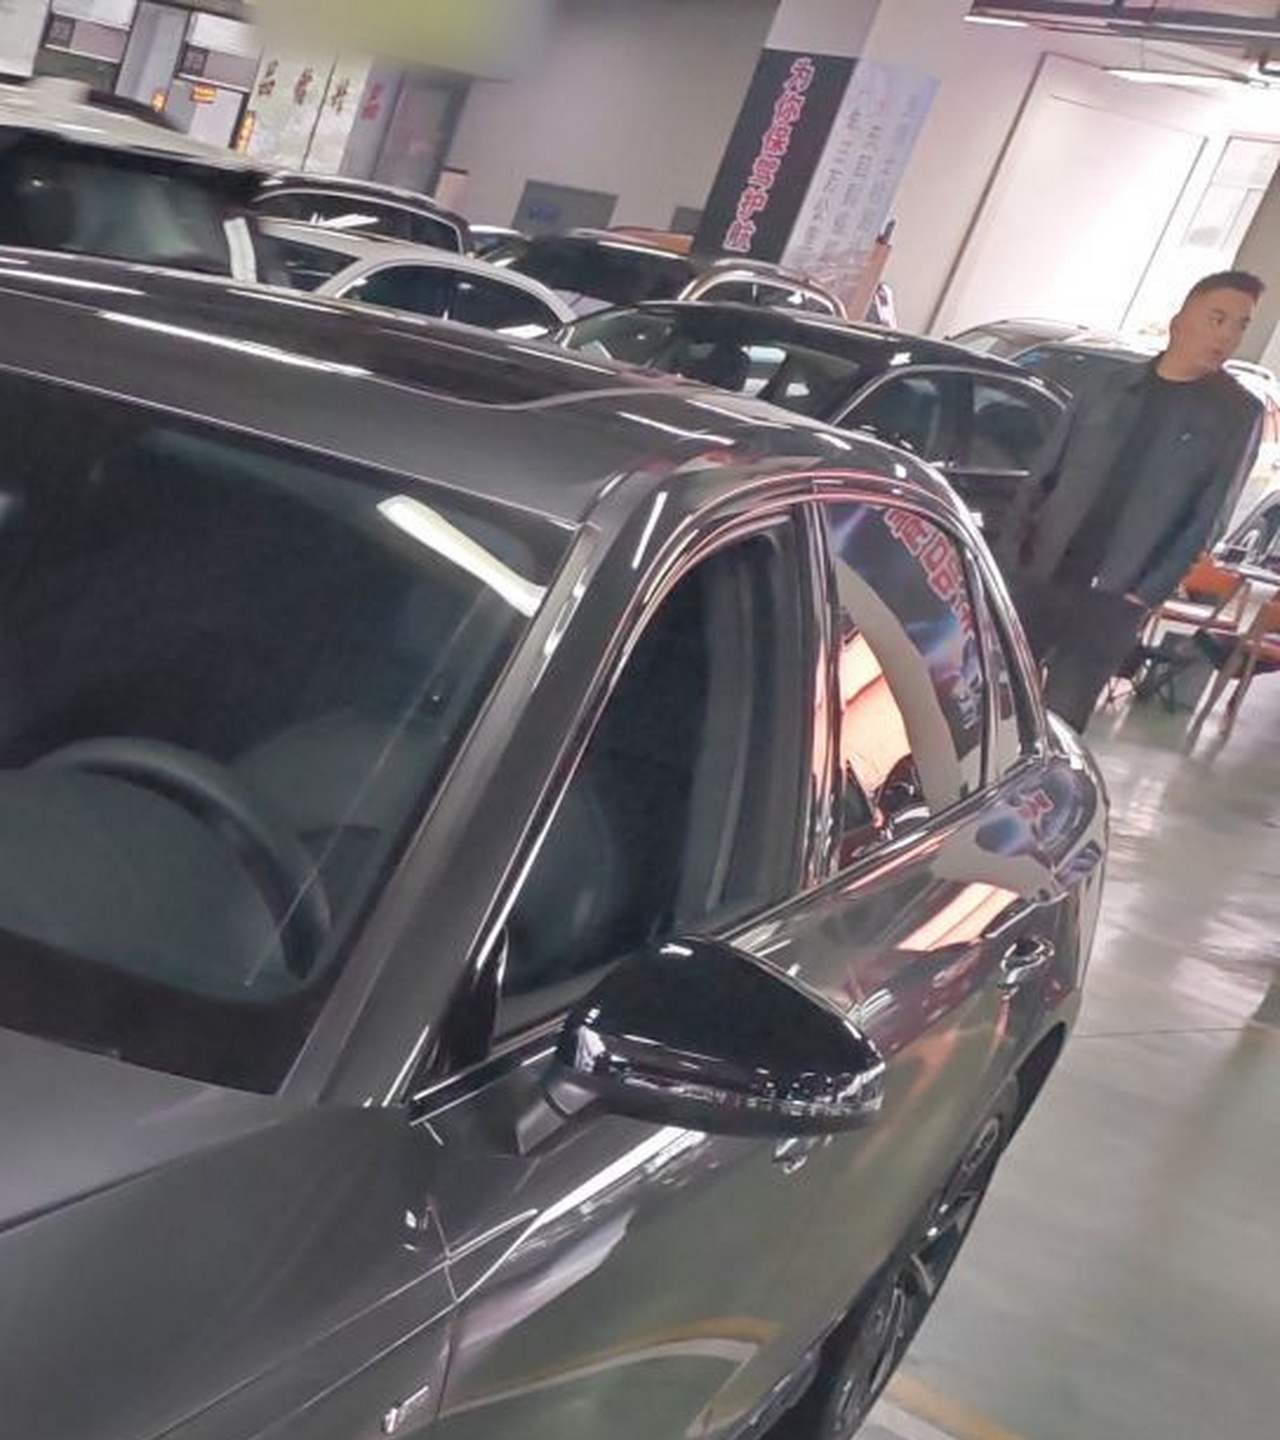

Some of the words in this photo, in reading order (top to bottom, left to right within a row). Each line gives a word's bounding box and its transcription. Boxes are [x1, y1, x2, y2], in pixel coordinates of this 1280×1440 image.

[723, 56, 815, 252] 为你保驾护航
